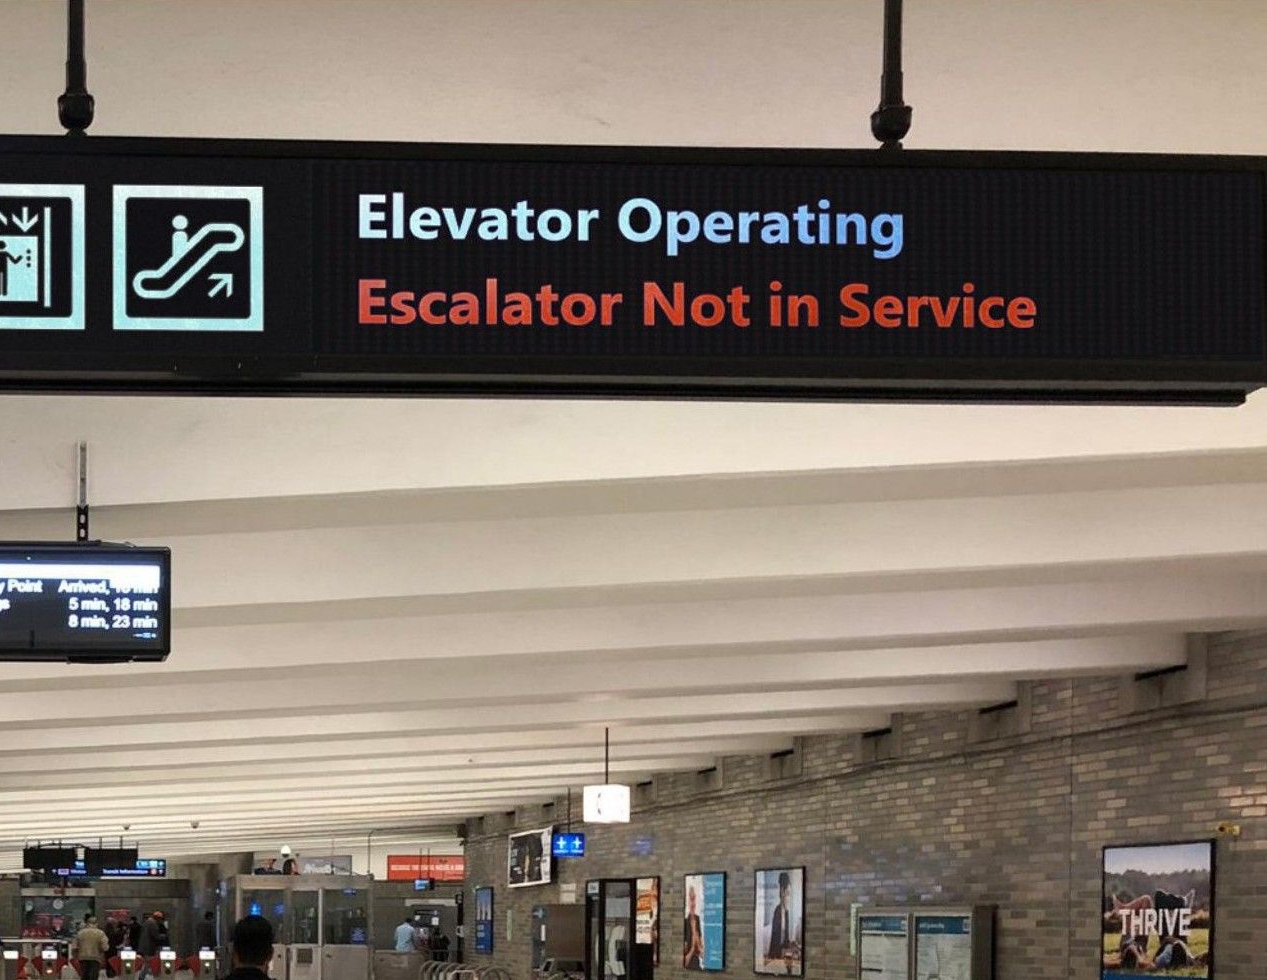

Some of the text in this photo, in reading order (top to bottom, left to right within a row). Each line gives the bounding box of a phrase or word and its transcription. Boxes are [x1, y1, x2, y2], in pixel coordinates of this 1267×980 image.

[357, 191, 905, 260] Elevator Operating
[357, 277, 1037, 330] Escalator Not in Service
[7, 578, 43, 592] Point
[68, 597, 158, 613] 5 min, 18 min
[68, 614, 158, 630] 8 min, 23 min
[1119, 907, 1192, 936] THRIVE
